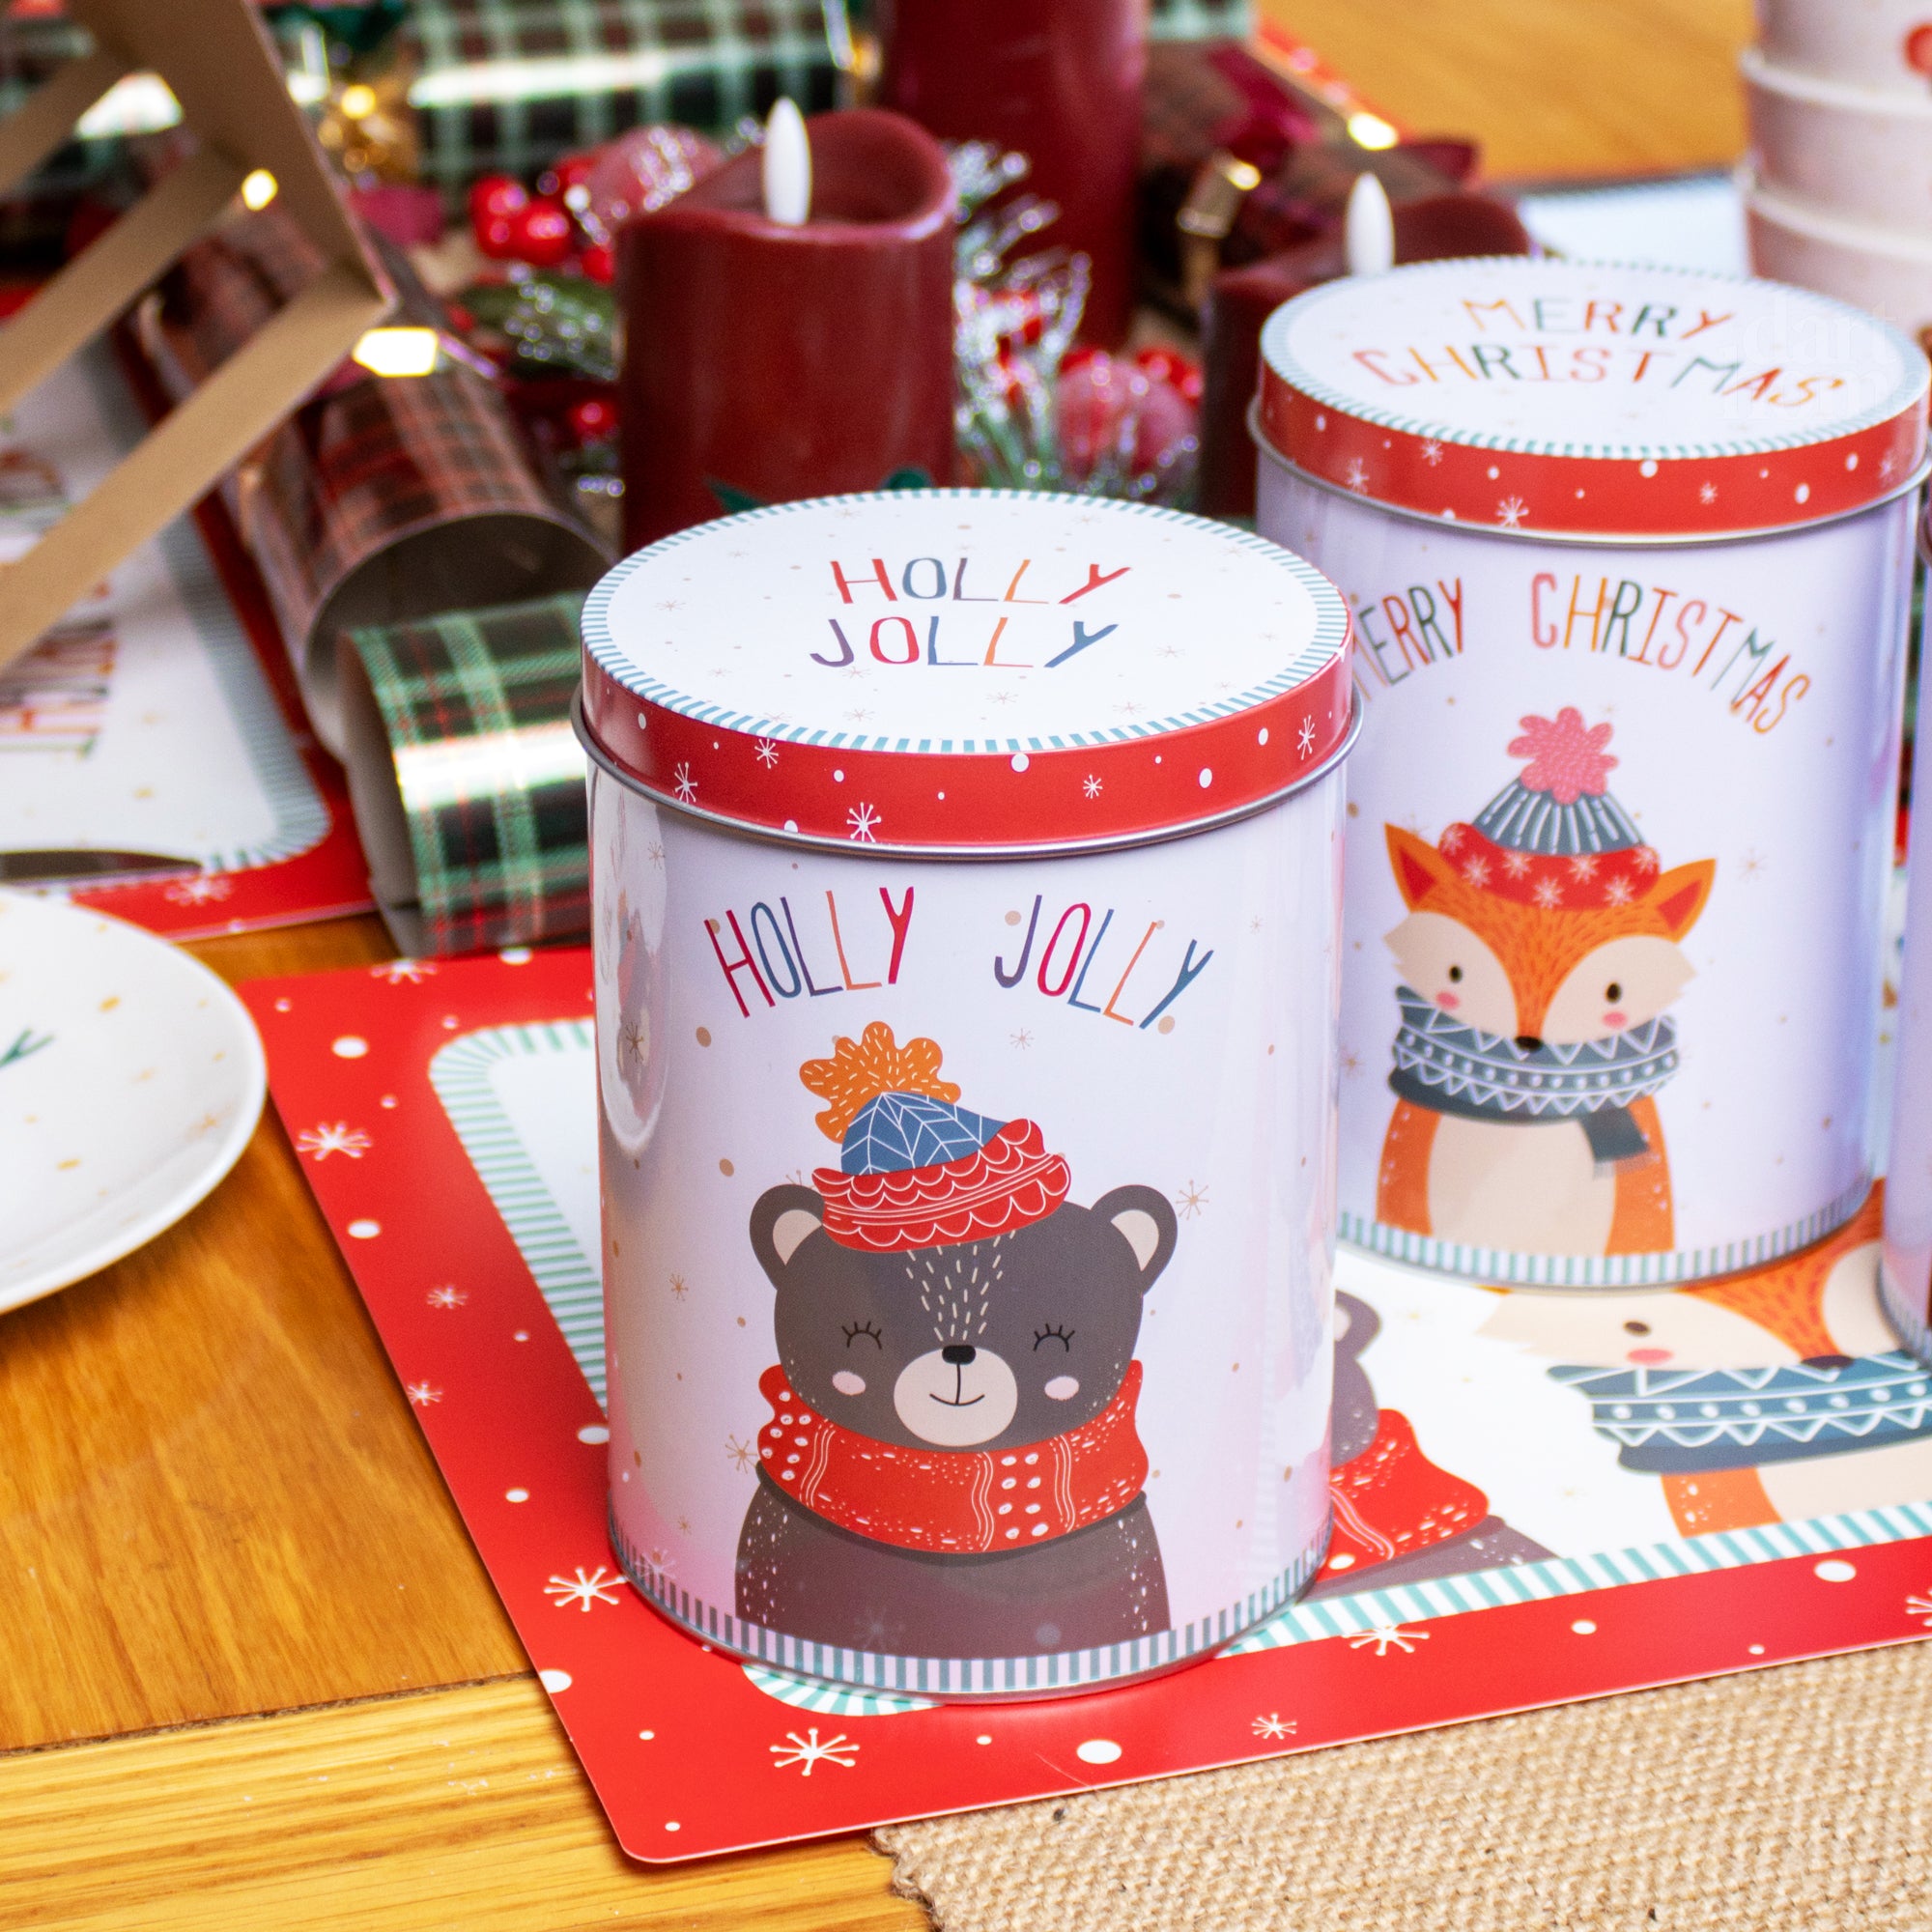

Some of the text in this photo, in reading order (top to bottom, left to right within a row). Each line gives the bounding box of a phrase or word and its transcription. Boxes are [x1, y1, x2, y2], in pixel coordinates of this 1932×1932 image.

[1462, 297, 1736, 340] MERRY
[1352, 344, 1845, 408] CHRISTMAS
[829, 556, 1133, 605] HOLLY
[809, 615, 1120, 668] JOLLY
[1530, 572, 1811, 734] CHRISTMAS
[703, 885, 1215, 1030] HOLLY JOLLY
